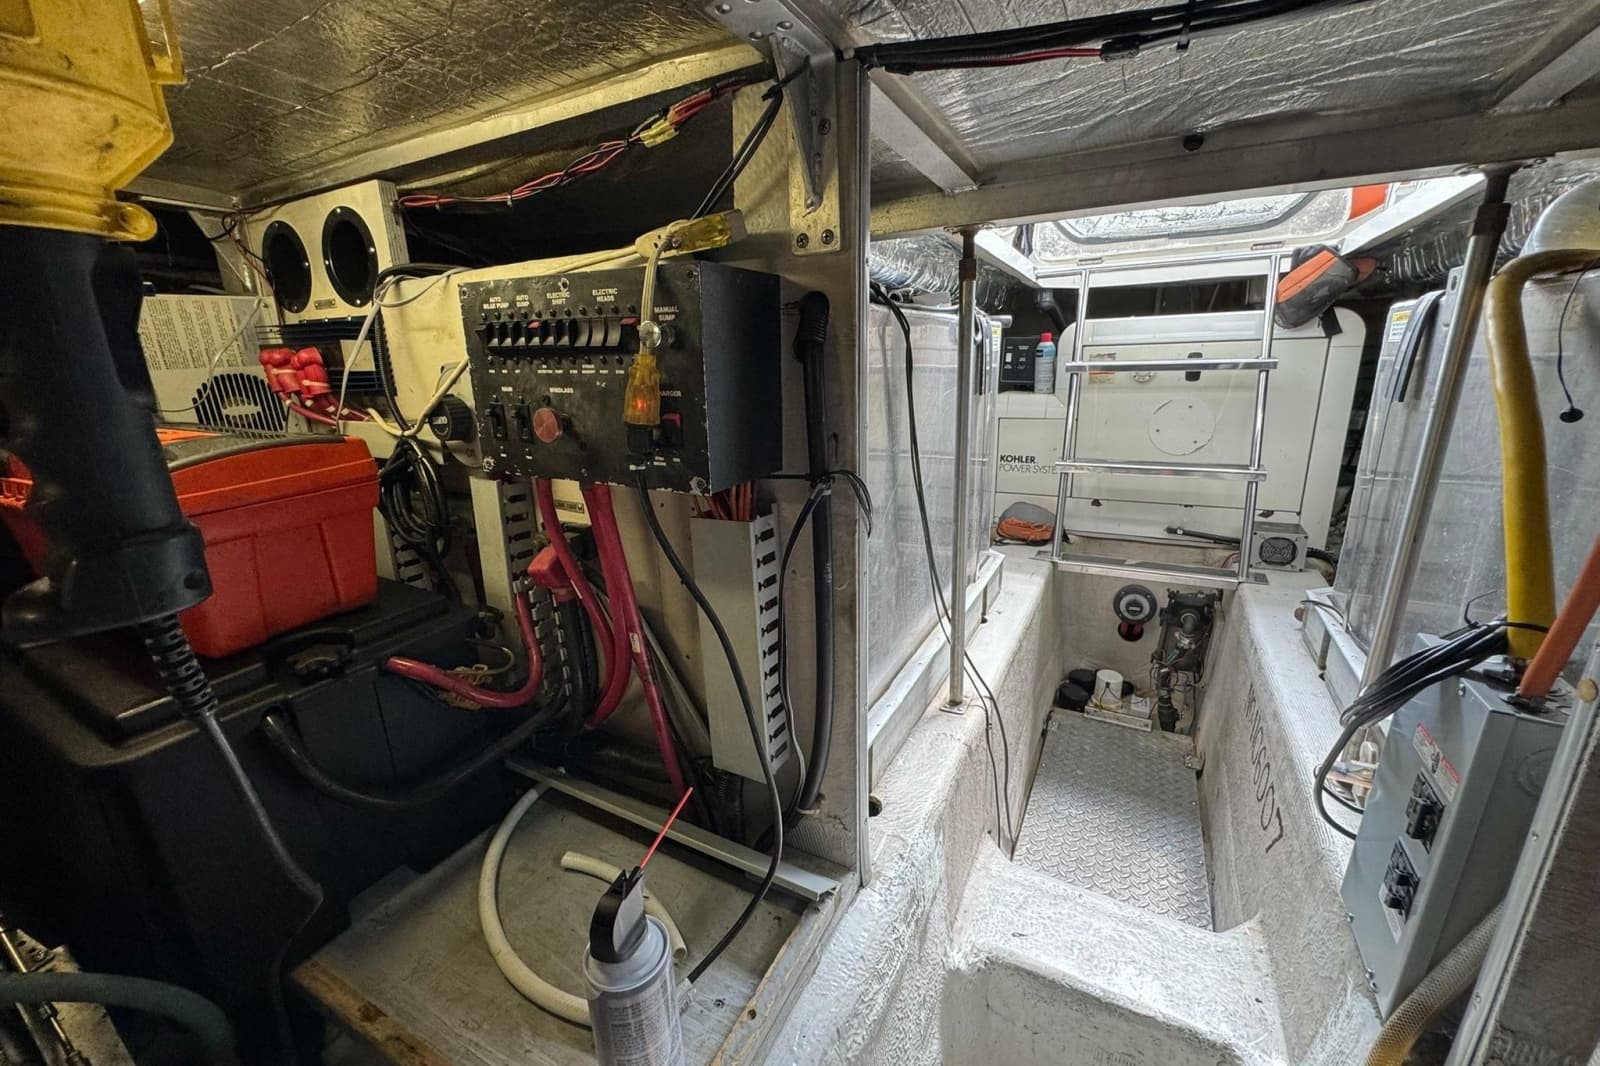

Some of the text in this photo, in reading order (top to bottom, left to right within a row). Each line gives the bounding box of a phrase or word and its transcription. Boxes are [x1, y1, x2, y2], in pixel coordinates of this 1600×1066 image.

[592, 288, 618, 296] ELECTRIC
[596, 295, 615, 303] HEADS
[999, 454, 1037, 464] KOHLER
[999, 463, 1058, 475] POWER SYSTE
